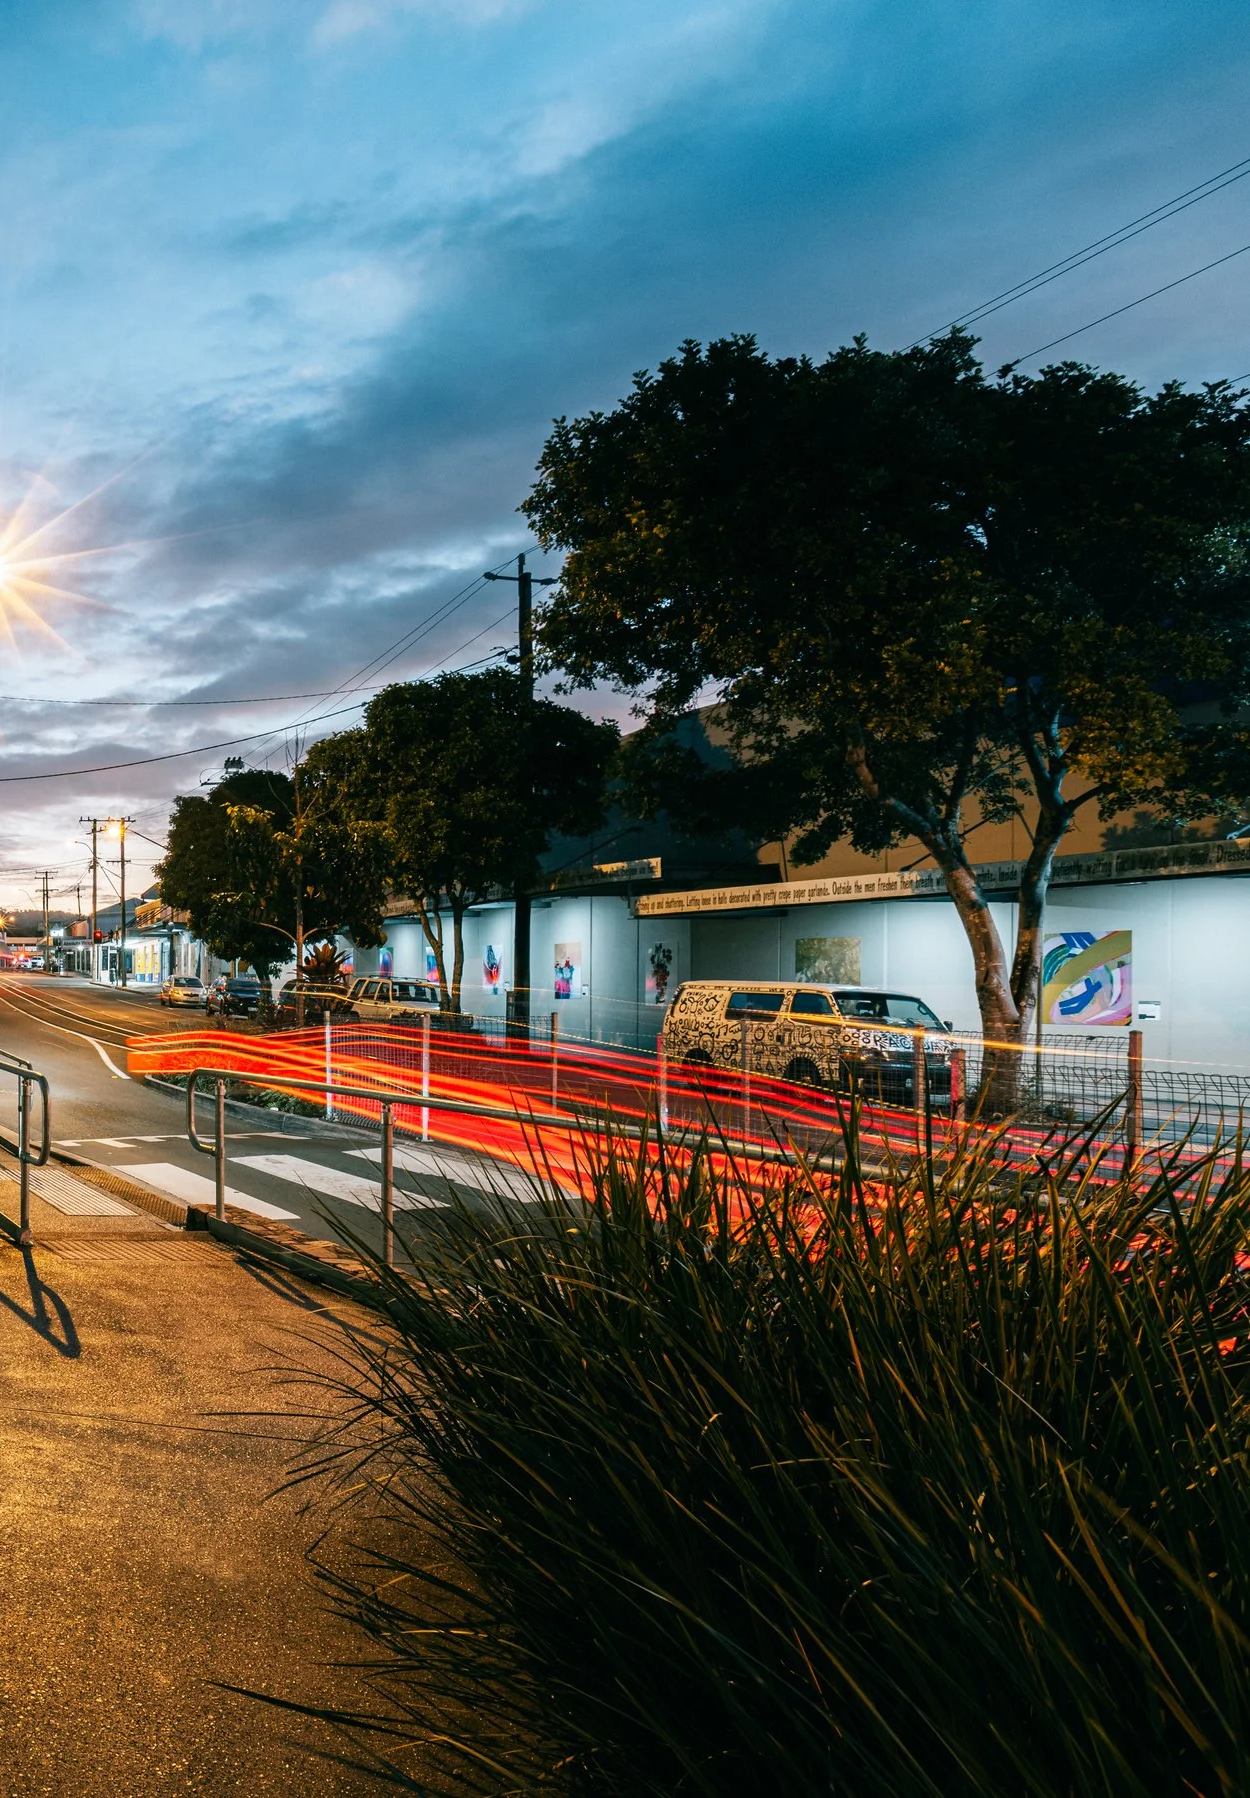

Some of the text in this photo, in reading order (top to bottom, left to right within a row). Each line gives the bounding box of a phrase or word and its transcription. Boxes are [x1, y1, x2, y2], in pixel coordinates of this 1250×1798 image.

[793, 888, 806, 903] paper
[832, 881, 852, 895] Outside
[854, 880, 862, 893] the
[865, 882, 876, 892] men
